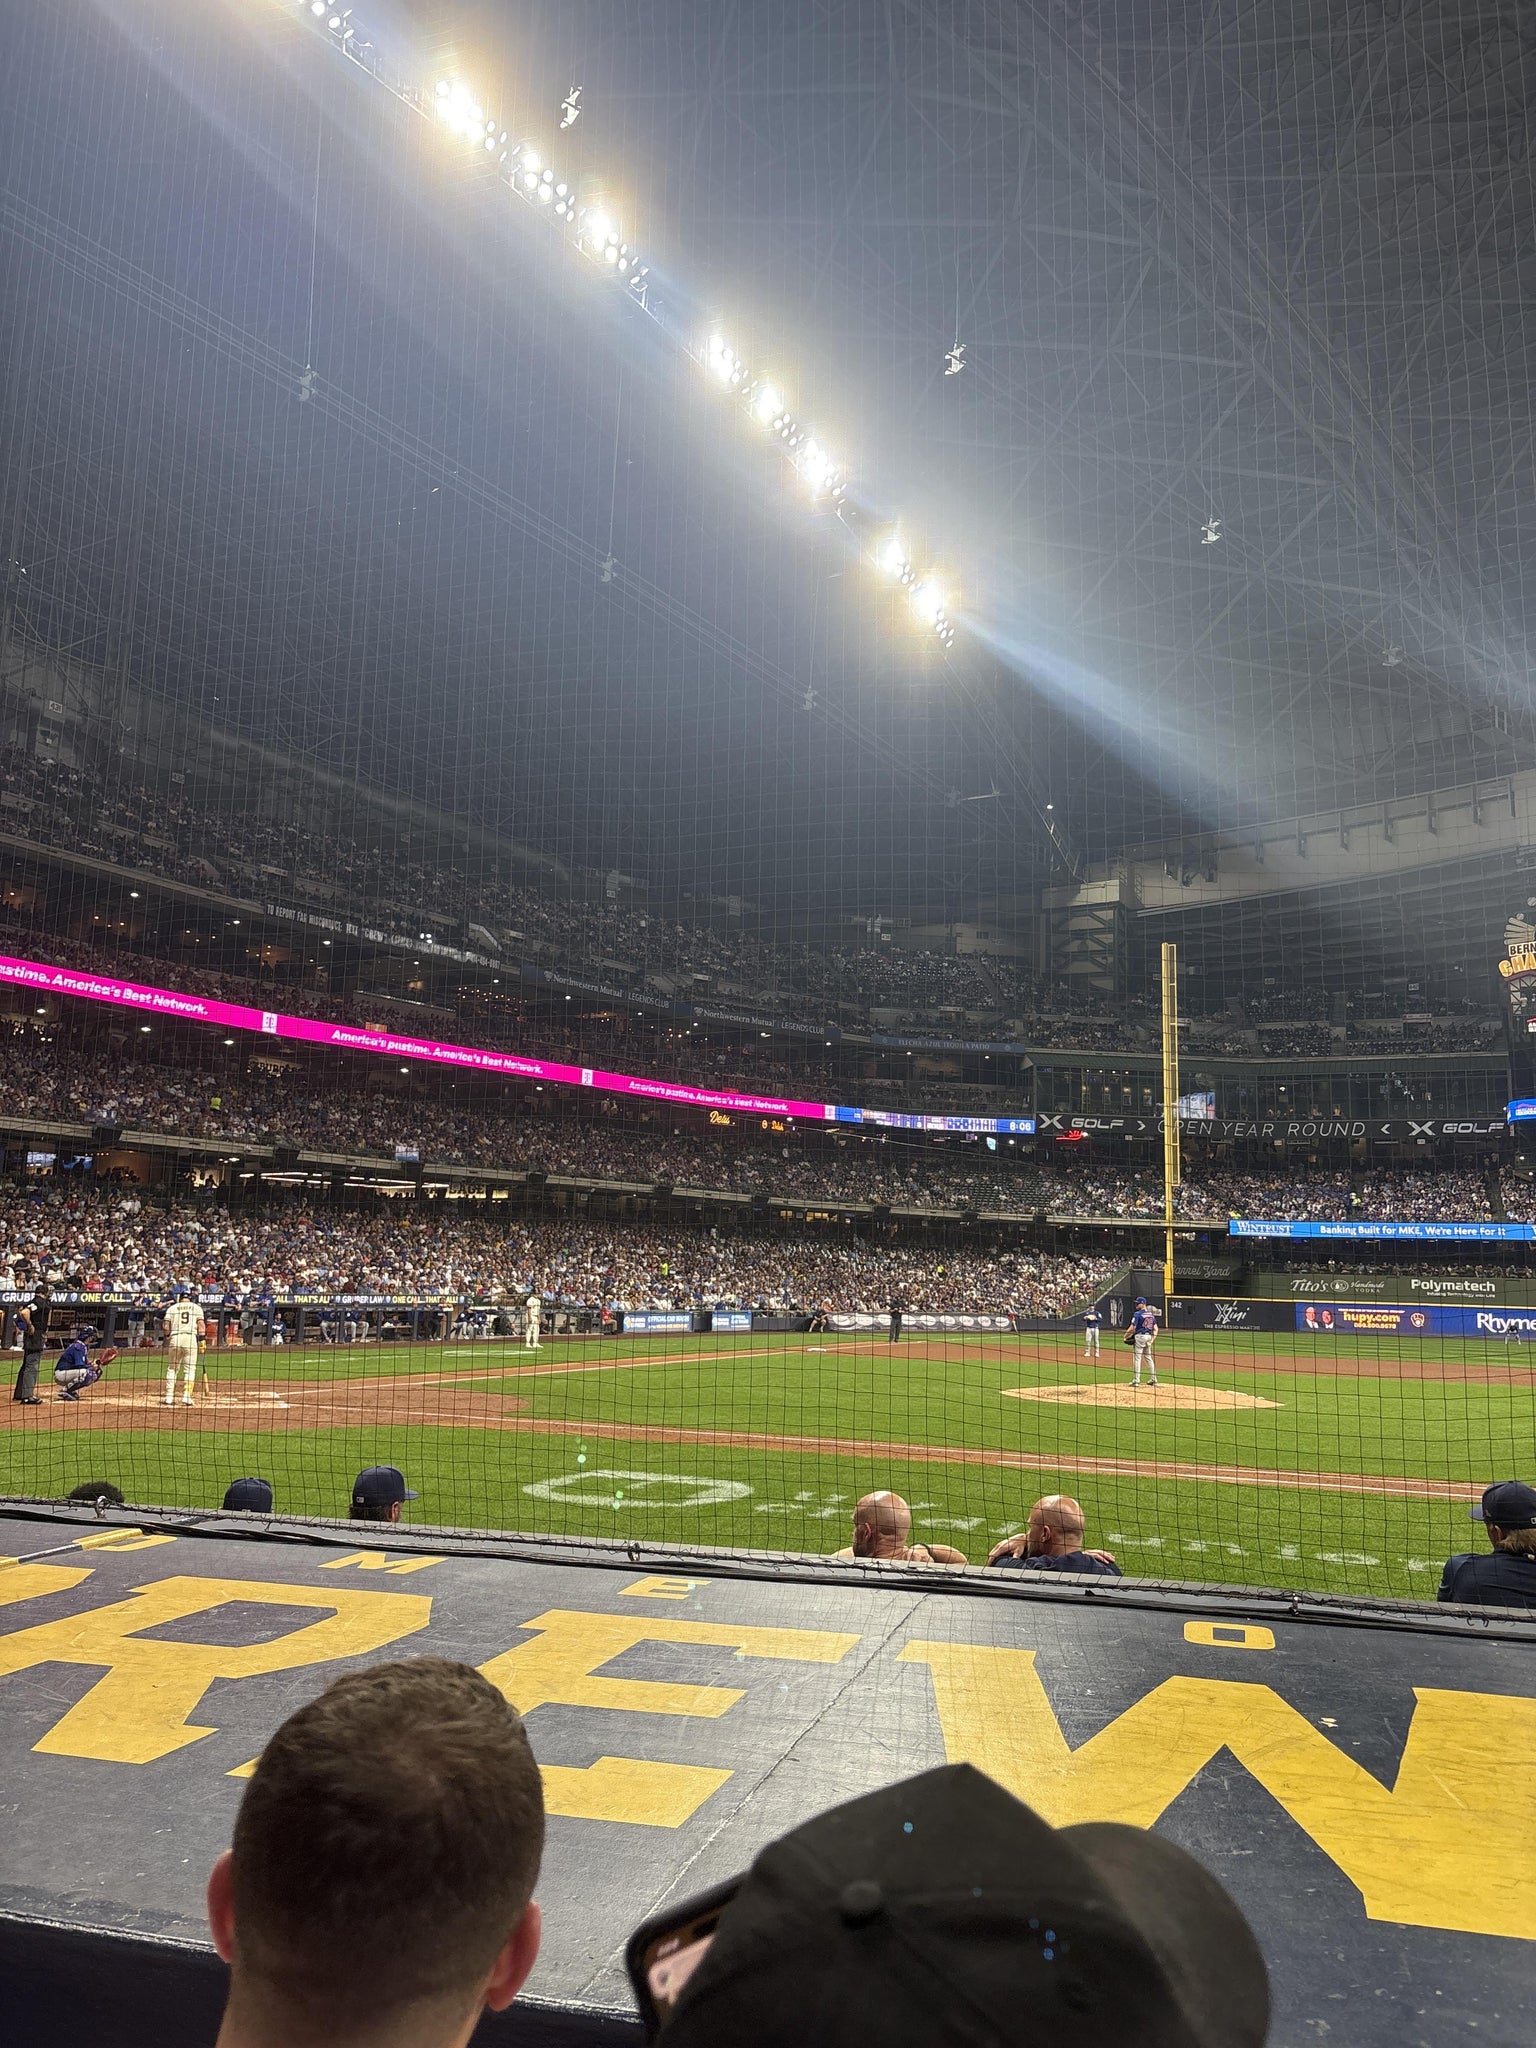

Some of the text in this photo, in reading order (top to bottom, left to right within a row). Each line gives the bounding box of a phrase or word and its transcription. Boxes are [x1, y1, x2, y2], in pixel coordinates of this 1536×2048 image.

[52, 973, 121, 998] America's
[122, 988, 152, 1004] Best
[152, 994, 209, 1016] Network.
[703, 1009, 775, 1027] Northwestern Mutual
[781, 1021, 825, 1035] LEGENDS CLUB
[331, 1030, 387, 1048] America's
[387, 1040, 432, 1056] pastime.
[433, 1047, 481, 1064] America's
[481, 1055, 503, 1067] Best
[1009, 1122, 1031, 1132] 8:06
[1039, 1114, 1125, 1129] X GOLF
[1222, 1122, 1275, 1137] YEAR
[1287, 1122, 1366, 1137] ROUND
[1407, 1121, 1505, 1136] X GOLF
[1236, 1221, 1294, 1234] WINTRUST
[1320, 1225, 1506, 1236] Banking Built for MKE, We're Here For It
[1174, 1264, 1201, 1276] arrel
[1290, 1279, 1328, 1292] Tito's
[1411, 1279, 1496, 1292] Polymatech
[2, 1292, 36, 1303] GRUBE
[80, 1292, 101, 1303] ONE
[392, 1295, 406, 1304] ONE
[1170, 1301, 1182, 1309] 342
[181, 1311, 190, 1325] 9
[1343, 1311, 1400, 1323] hupy.com
